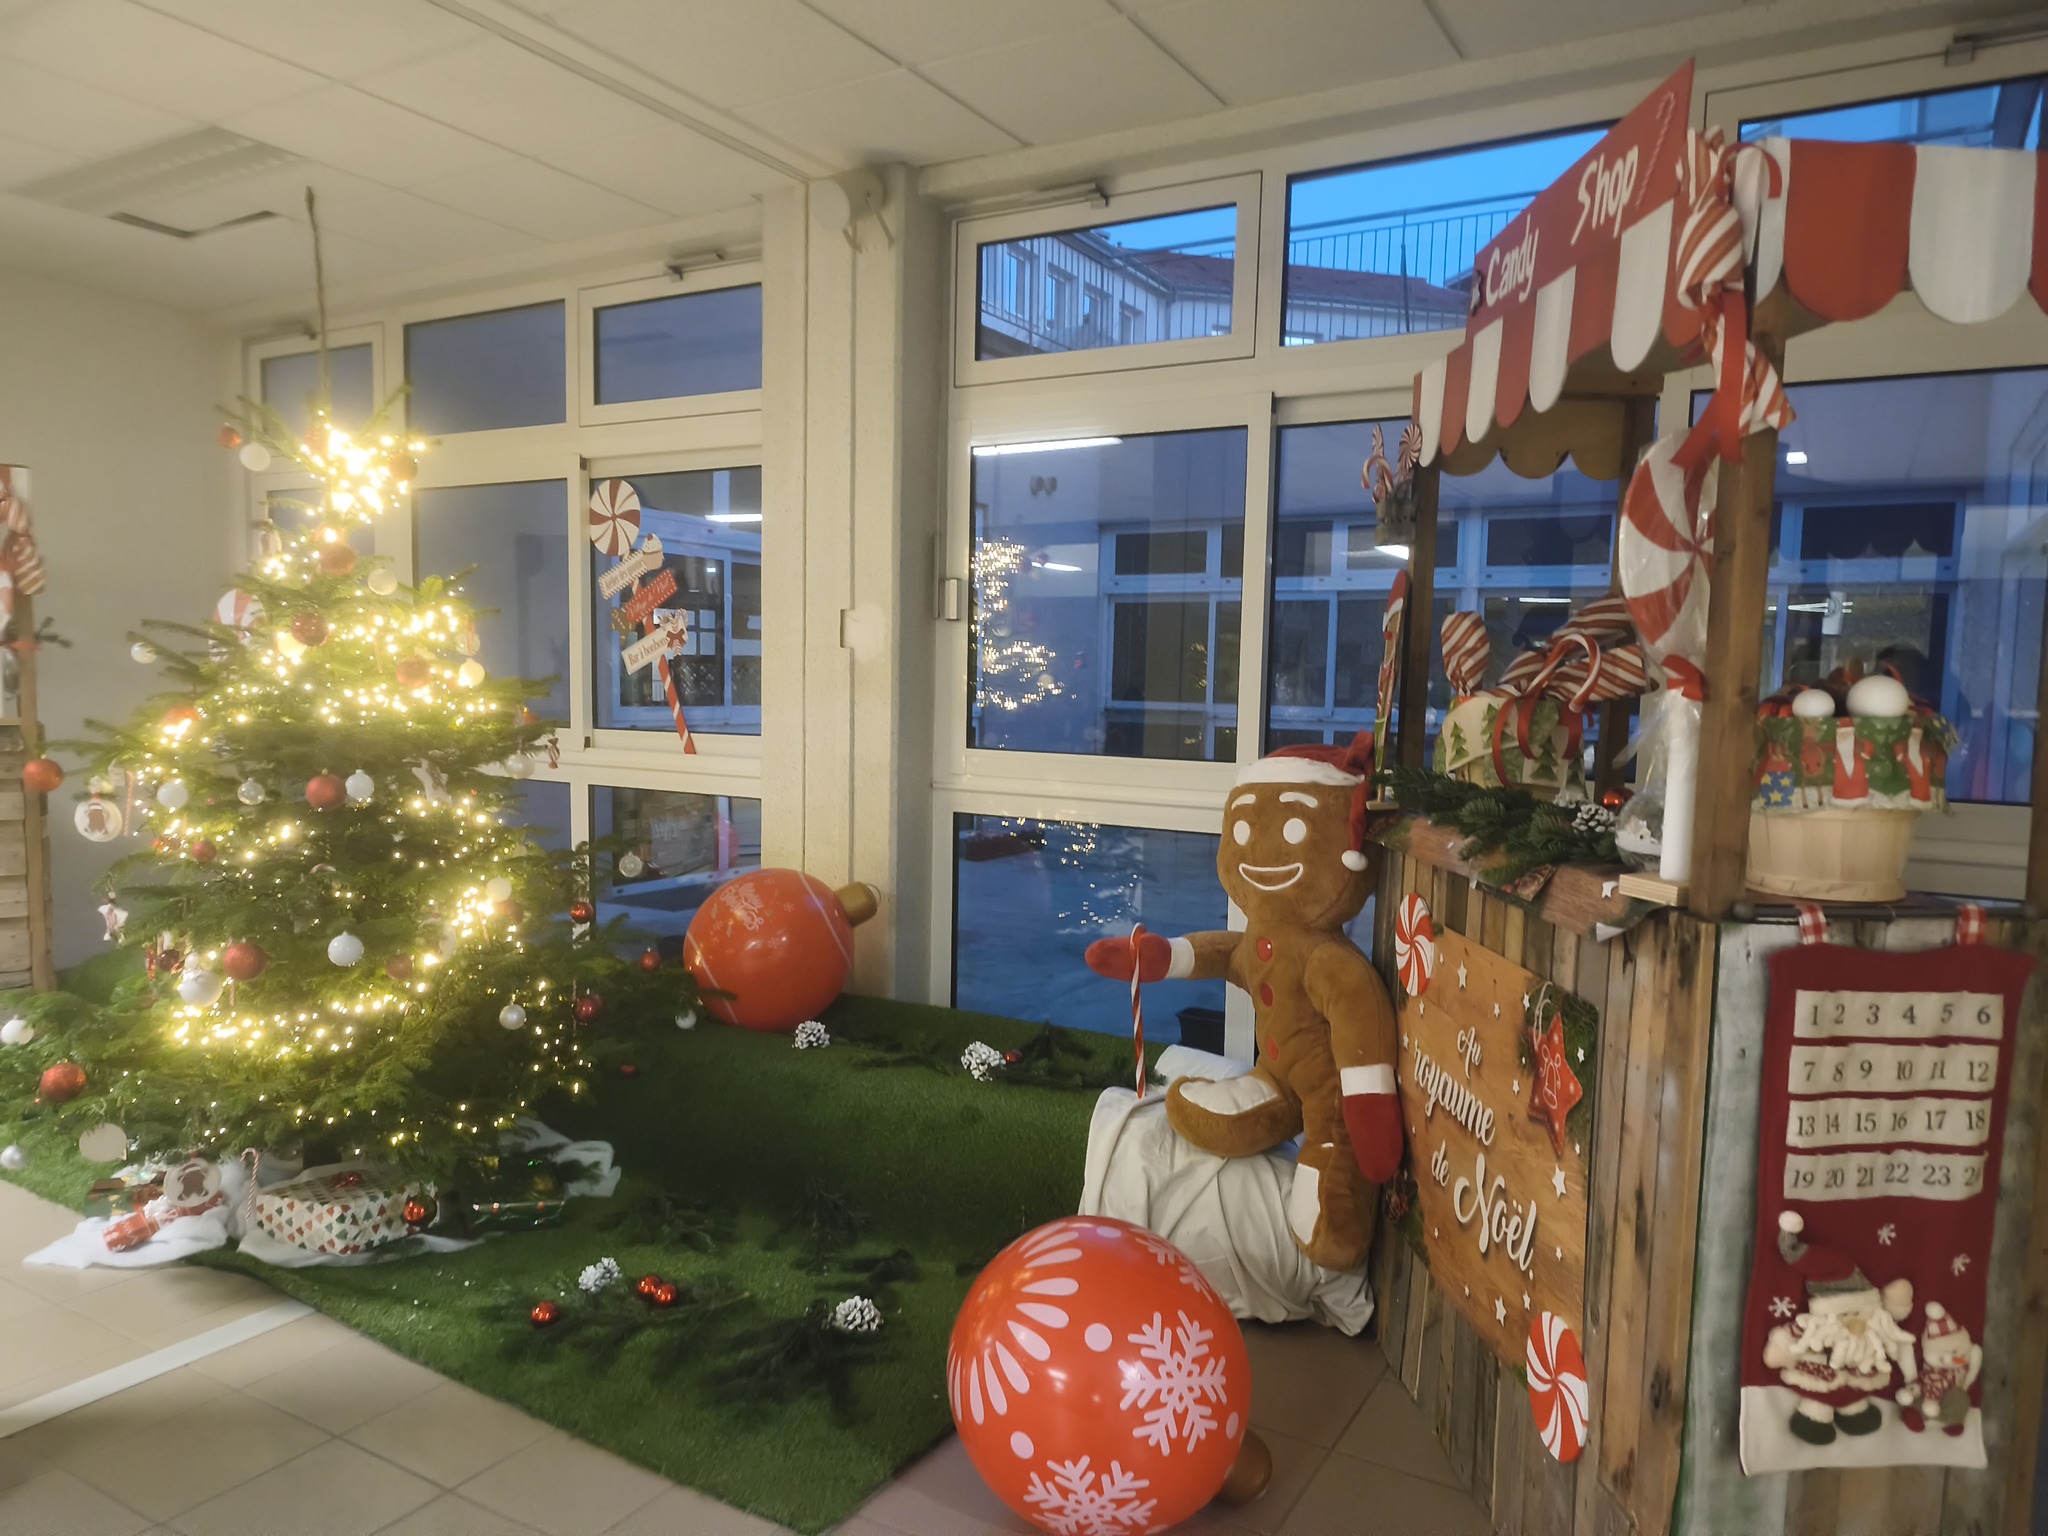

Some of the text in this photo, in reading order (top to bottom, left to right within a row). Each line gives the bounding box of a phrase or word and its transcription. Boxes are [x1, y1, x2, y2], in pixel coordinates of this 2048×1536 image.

[1485, 145, 1639, 307] Candy Shop
[1811, 1004, 1991, 1026] 1 2 3 4 5 6
[1457, 1026, 1482, 1080] Au
[1804, 1060, 1989, 1082] 7 8 9 10 11 12
[1413, 1039, 1496, 1146] royaume
[1796, 1109, 1985, 1136] 13 14 15 16 17 18
[1431, 1139, 1449, 1187] de
[1792, 1169, 1814, 1188] 19
[1824, 1168, 1844, 1188] 20
[1857, 1168, 1874, 1187] 21
[1884, 1163, 1909, 1184] 22
[1922, 1165, 1951, 1186] 23
